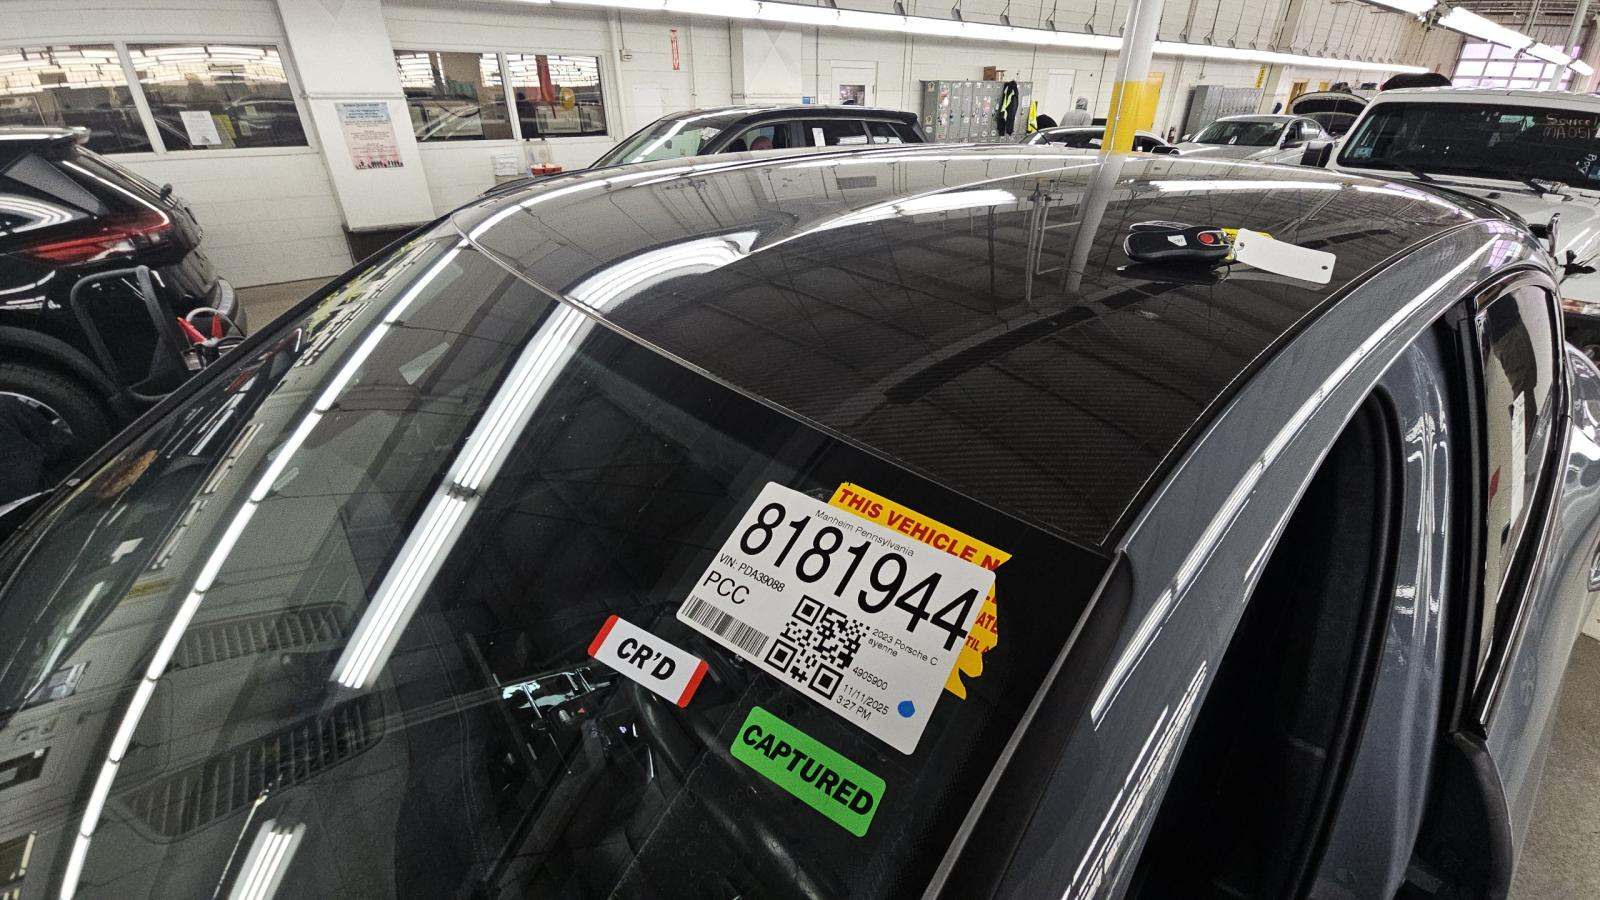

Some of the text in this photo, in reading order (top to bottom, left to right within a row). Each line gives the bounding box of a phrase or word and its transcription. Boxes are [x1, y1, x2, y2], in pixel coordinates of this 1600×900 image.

[814, 509, 915, 558] Manheim Pennsylvania
[838, 488, 883, 519] THIS
[886, 510, 978, 563] VEHICLE
[703, 570, 750, 604] PCC
[719, 553, 786, 592] VIN: PDA39088
[740, 502, 980, 652] 8181944
[617, 637, 677, 682] CR'D
[867, 638, 898, 657] ayenne
[872, 628, 939, 666] 2023 Porsche C
[852, 666, 888, 691] 4905900
[836, 695, 872, 721] 3:27 PM
[843, 684, 889, 715] 11/11/2025
[742, 724, 874, 816] CAPTURED
